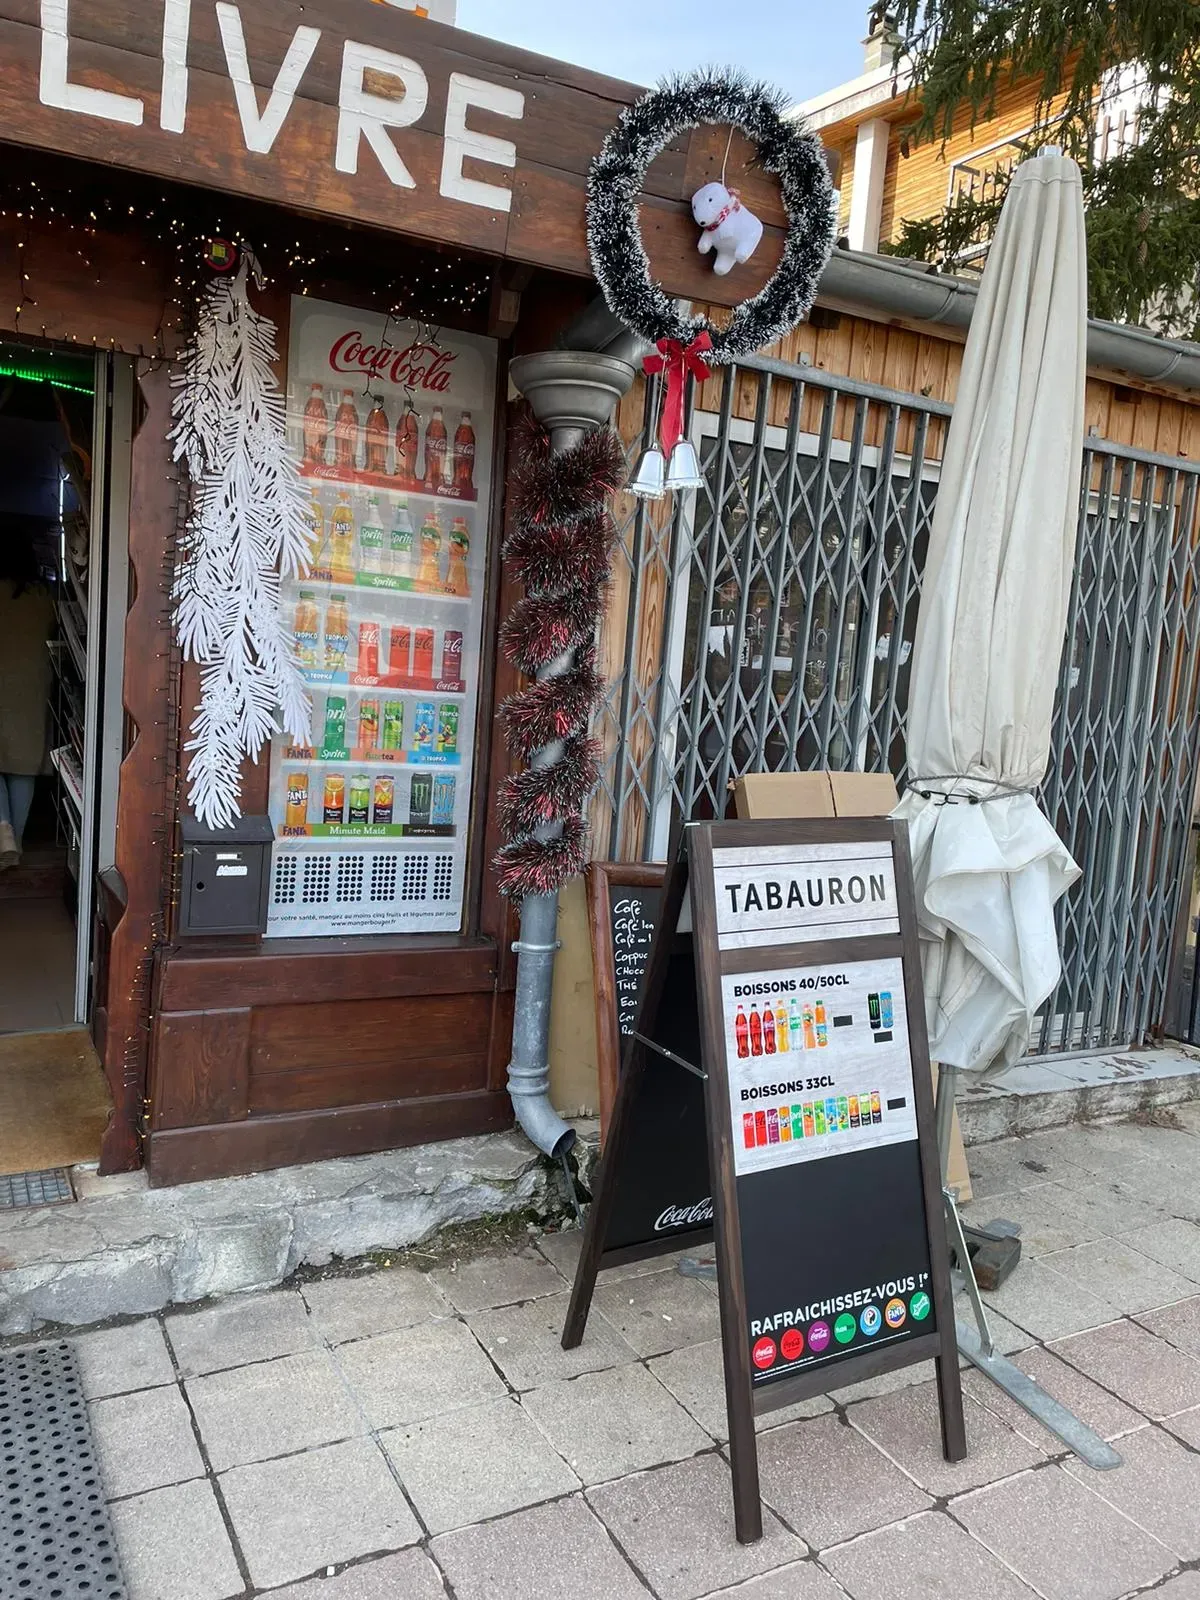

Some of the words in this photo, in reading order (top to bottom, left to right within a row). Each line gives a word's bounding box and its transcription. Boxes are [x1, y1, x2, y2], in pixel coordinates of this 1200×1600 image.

[40, 0, 525, 213] LIVRE
[328, 330, 460, 393] Coca-Cola
[372, 577, 398, 588] Sprite
[321, 748, 347, 760] Sprite
[329, 825, 362, 836] Minute
[363, 825, 387, 836] Maid
[724, 873, 887, 914] TABAURON
[613, 899, 642, 921] Café
[733, 979, 797, 998] BOISSONS
[799, 974, 850, 990] 40/50CL
[740, 1079, 804, 1101] BOISSONS
[805, 1074, 836, 1090] 33CL
[750, 1276, 916, 1337] RAFRAICHISSEZ-VOUS
